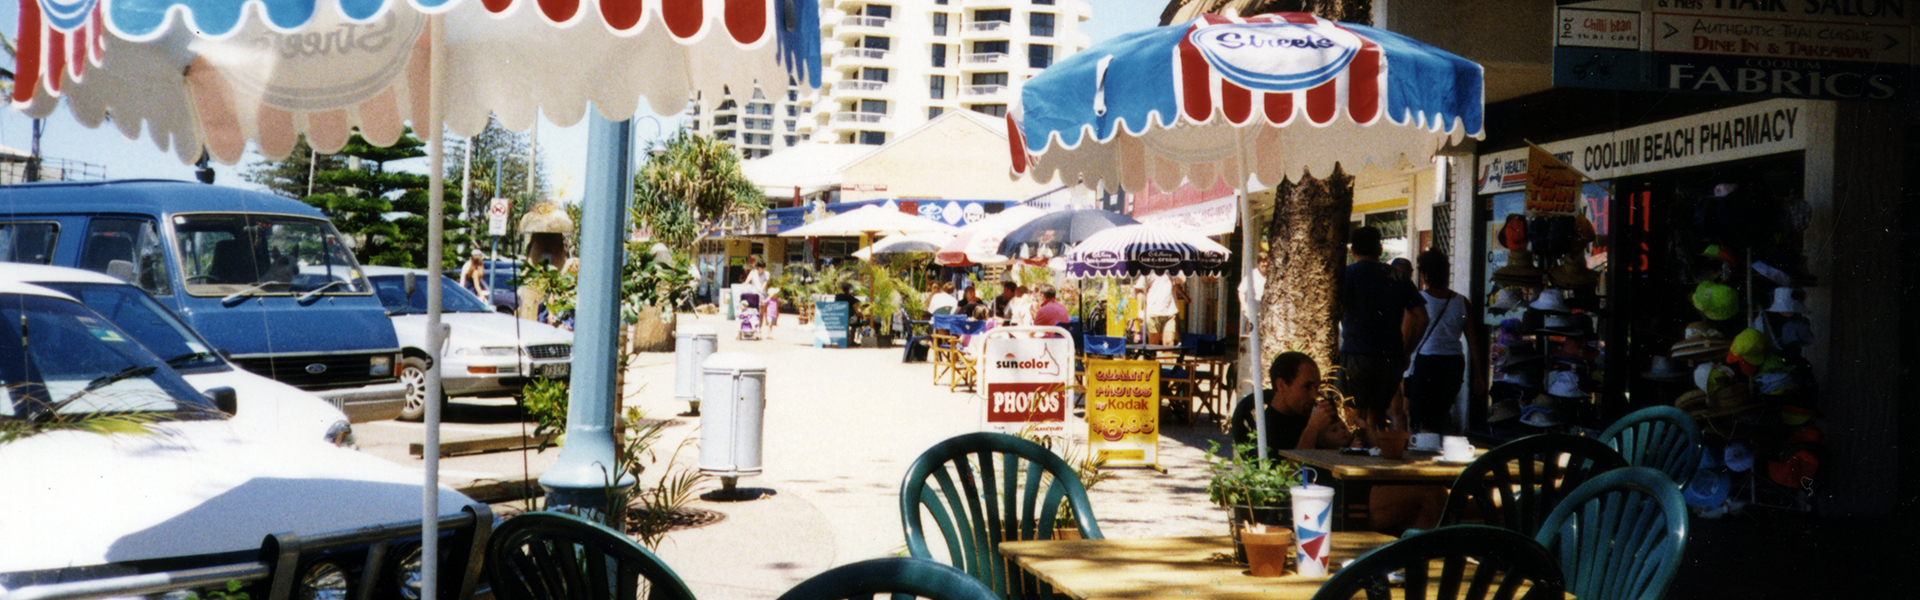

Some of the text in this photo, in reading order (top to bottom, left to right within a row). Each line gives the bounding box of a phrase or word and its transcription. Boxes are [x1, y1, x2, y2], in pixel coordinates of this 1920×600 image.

[1804, 0, 1904, 18] SALON
[1561, 17, 1574, 39] hot
[1610, 19, 1632, 33] bean
[1216, 32, 1335, 49] Streets
[1767, 43, 1780, 54] &
[1745, 58, 1822, 69] COOLUM
[1669, 64, 1895, 99] FABRICS
[1584, 107, 1798, 172] COOLUM BEACH PHARMACY
[996, 358, 1050, 369] suncolor
[1095, 368, 1154, 382] QUALITY
[1095, 383, 1152, 398] PHOTOS
[993, 391, 1060, 413] PHOTOS
[1107, 398, 1149, 410] Kodak
[1091, 414, 1155, 442] $8.95
